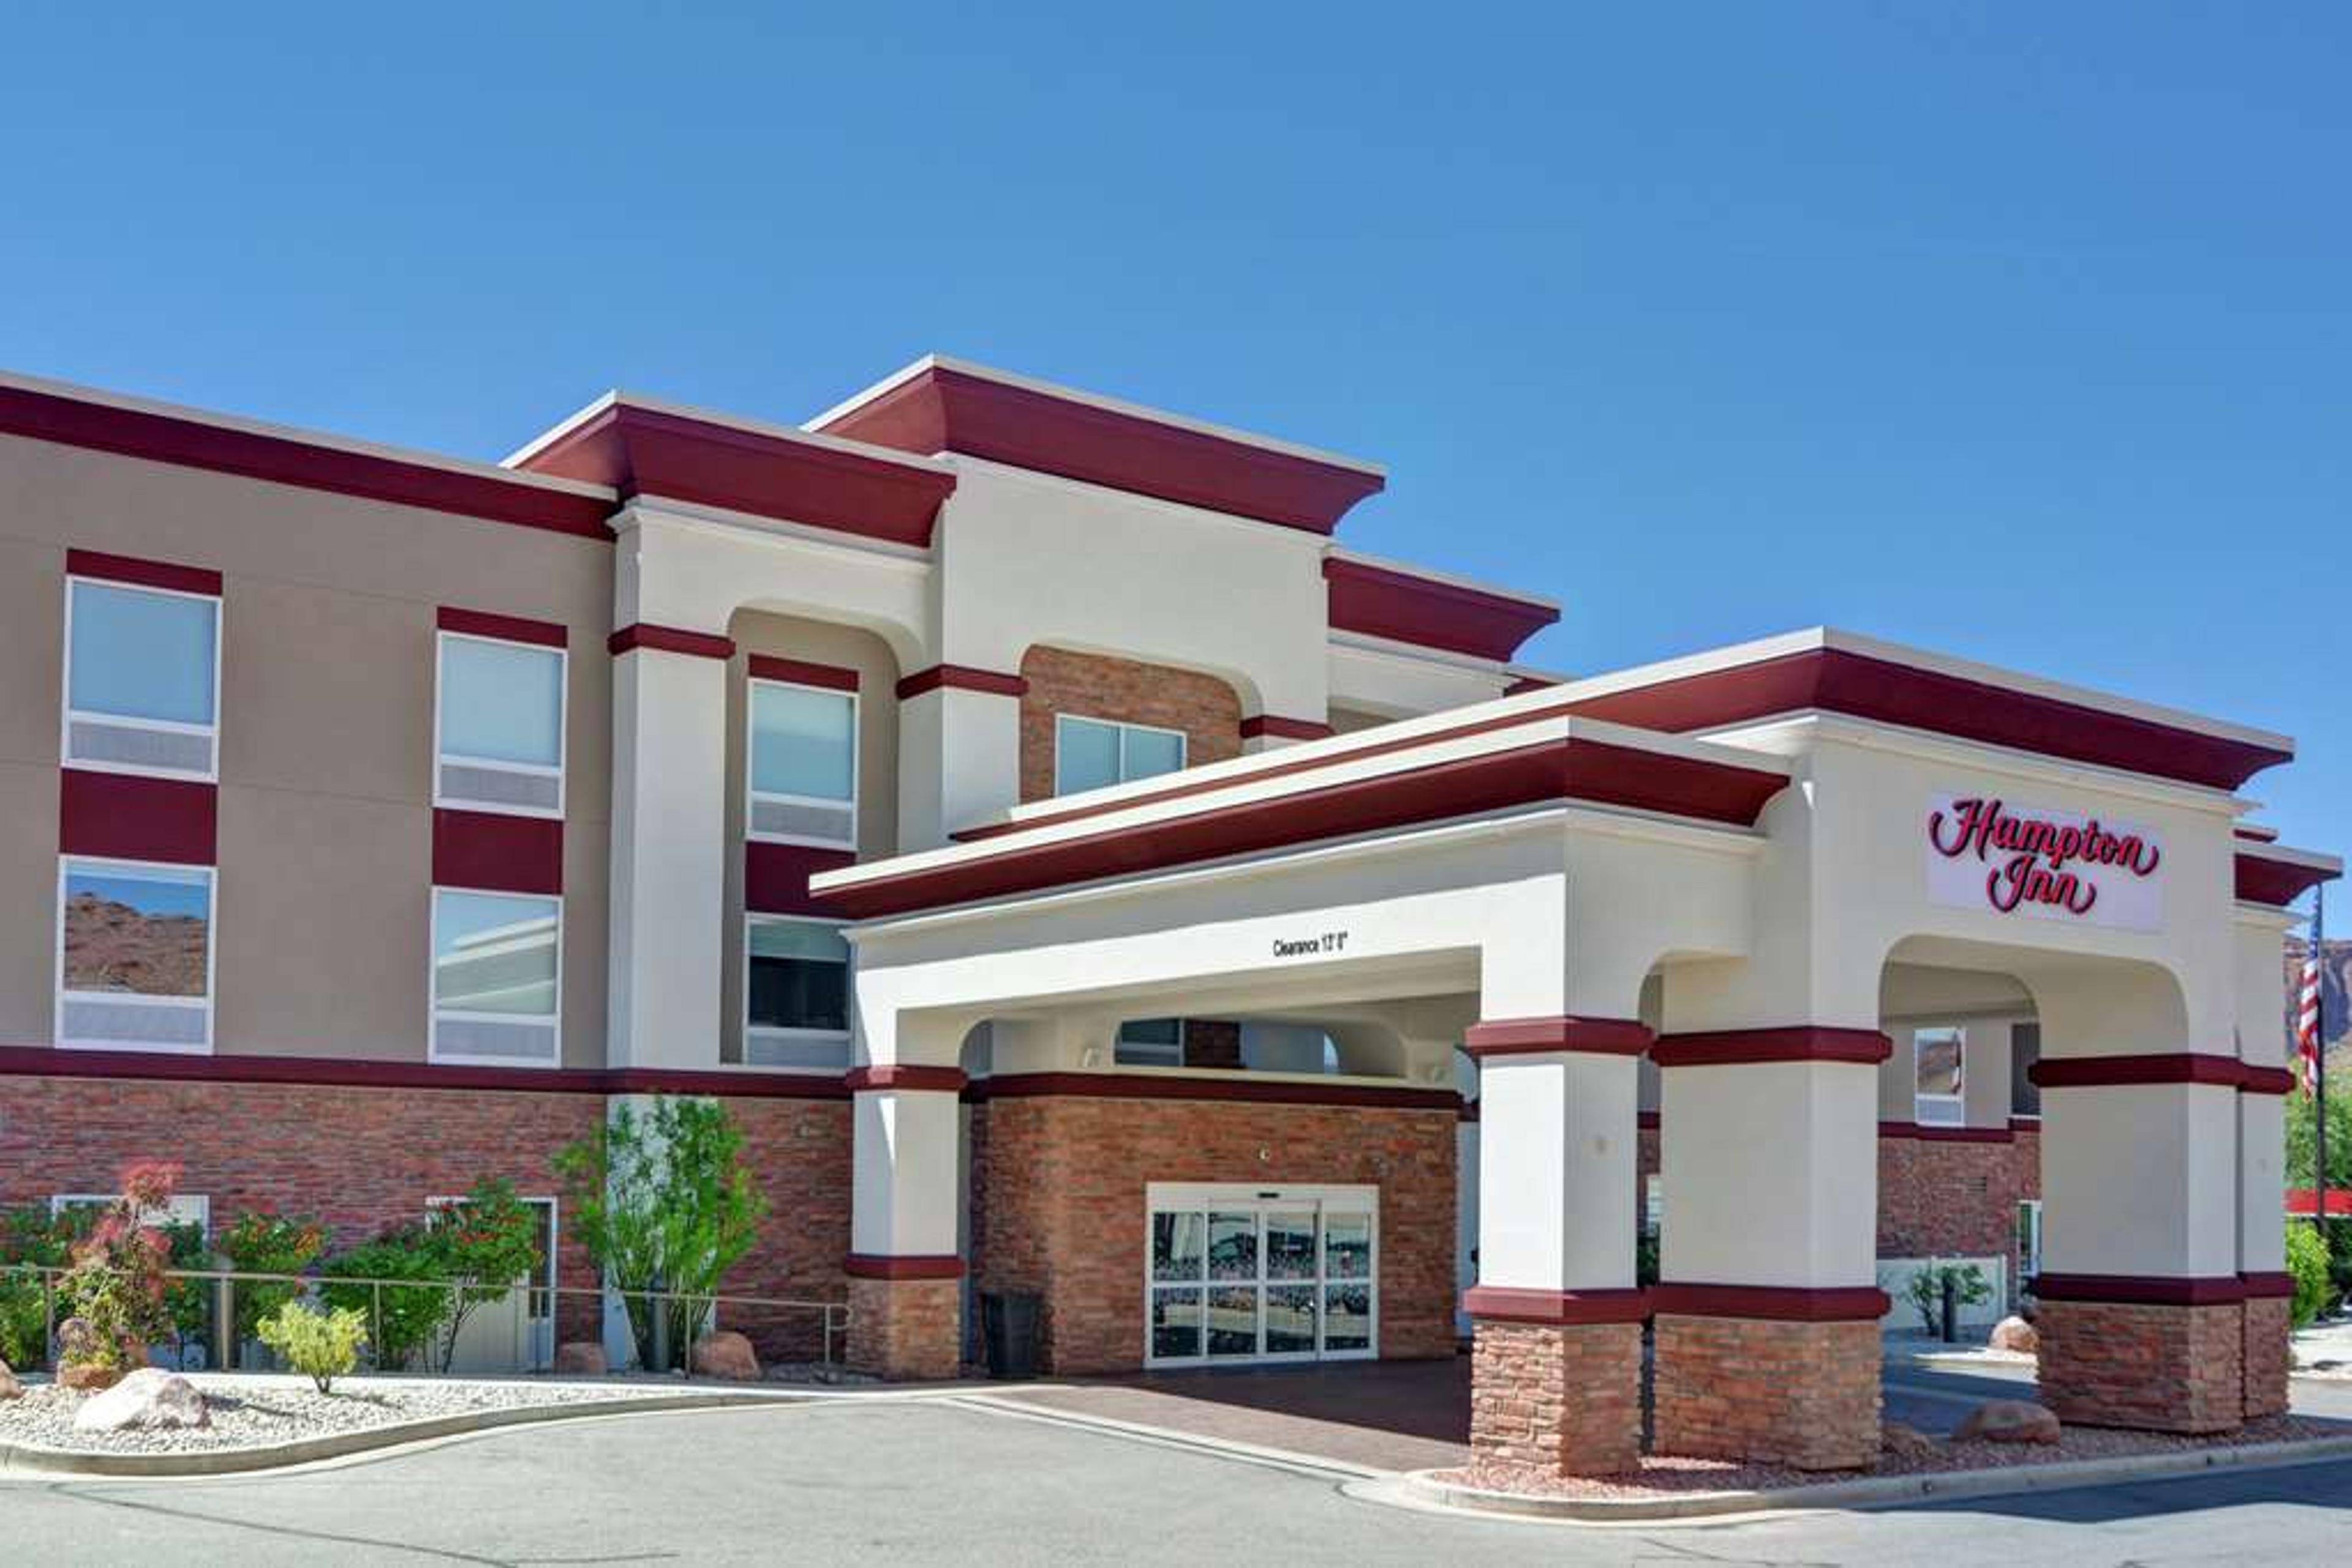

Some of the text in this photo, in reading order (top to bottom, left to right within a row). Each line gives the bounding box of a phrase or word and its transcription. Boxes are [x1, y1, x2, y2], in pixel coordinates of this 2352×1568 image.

[1928, 798, 2160, 876] Hampton
[1986, 855, 2097, 914] Inn
[1273, 939, 1319, 957] Clearance
